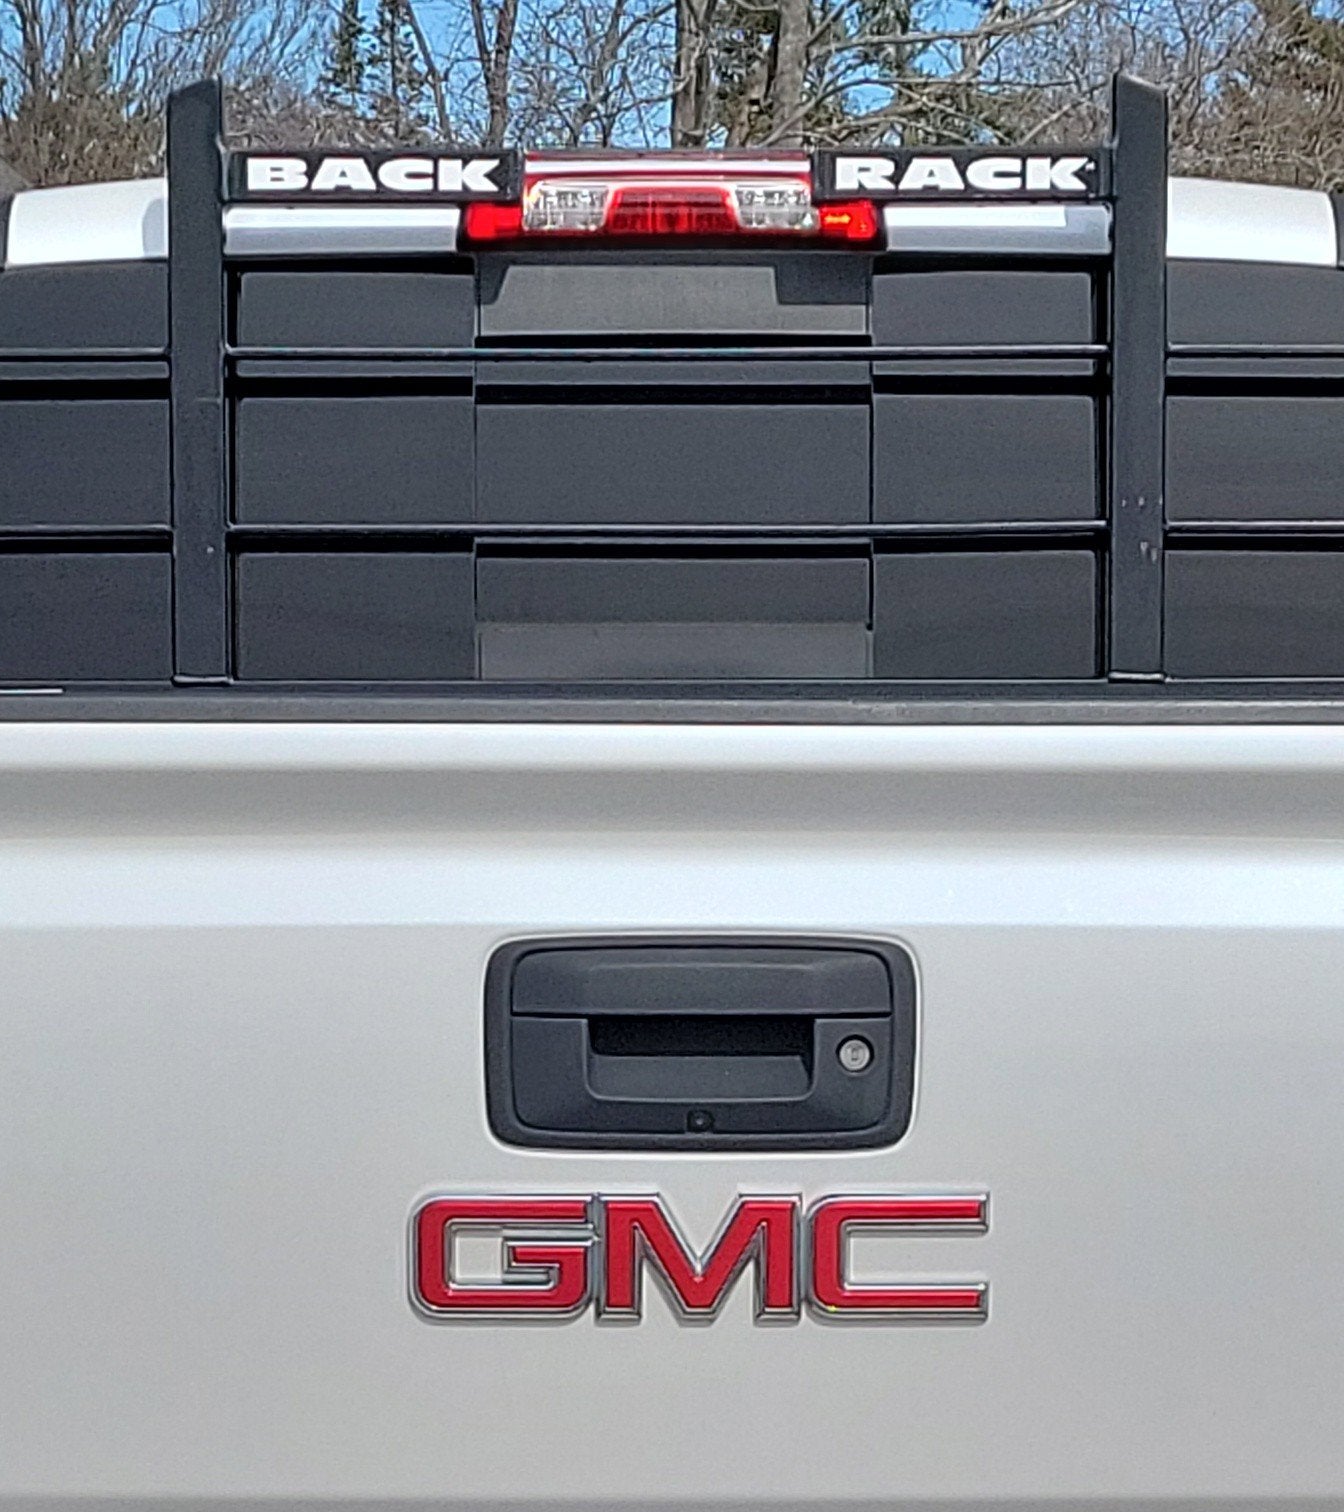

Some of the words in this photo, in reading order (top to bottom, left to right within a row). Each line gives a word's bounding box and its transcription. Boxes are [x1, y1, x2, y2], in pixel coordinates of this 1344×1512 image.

[247, 157, 500, 191] BACK
[834, 157, 1089, 190] RACK
[410, 1192, 990, 1325] GMC
